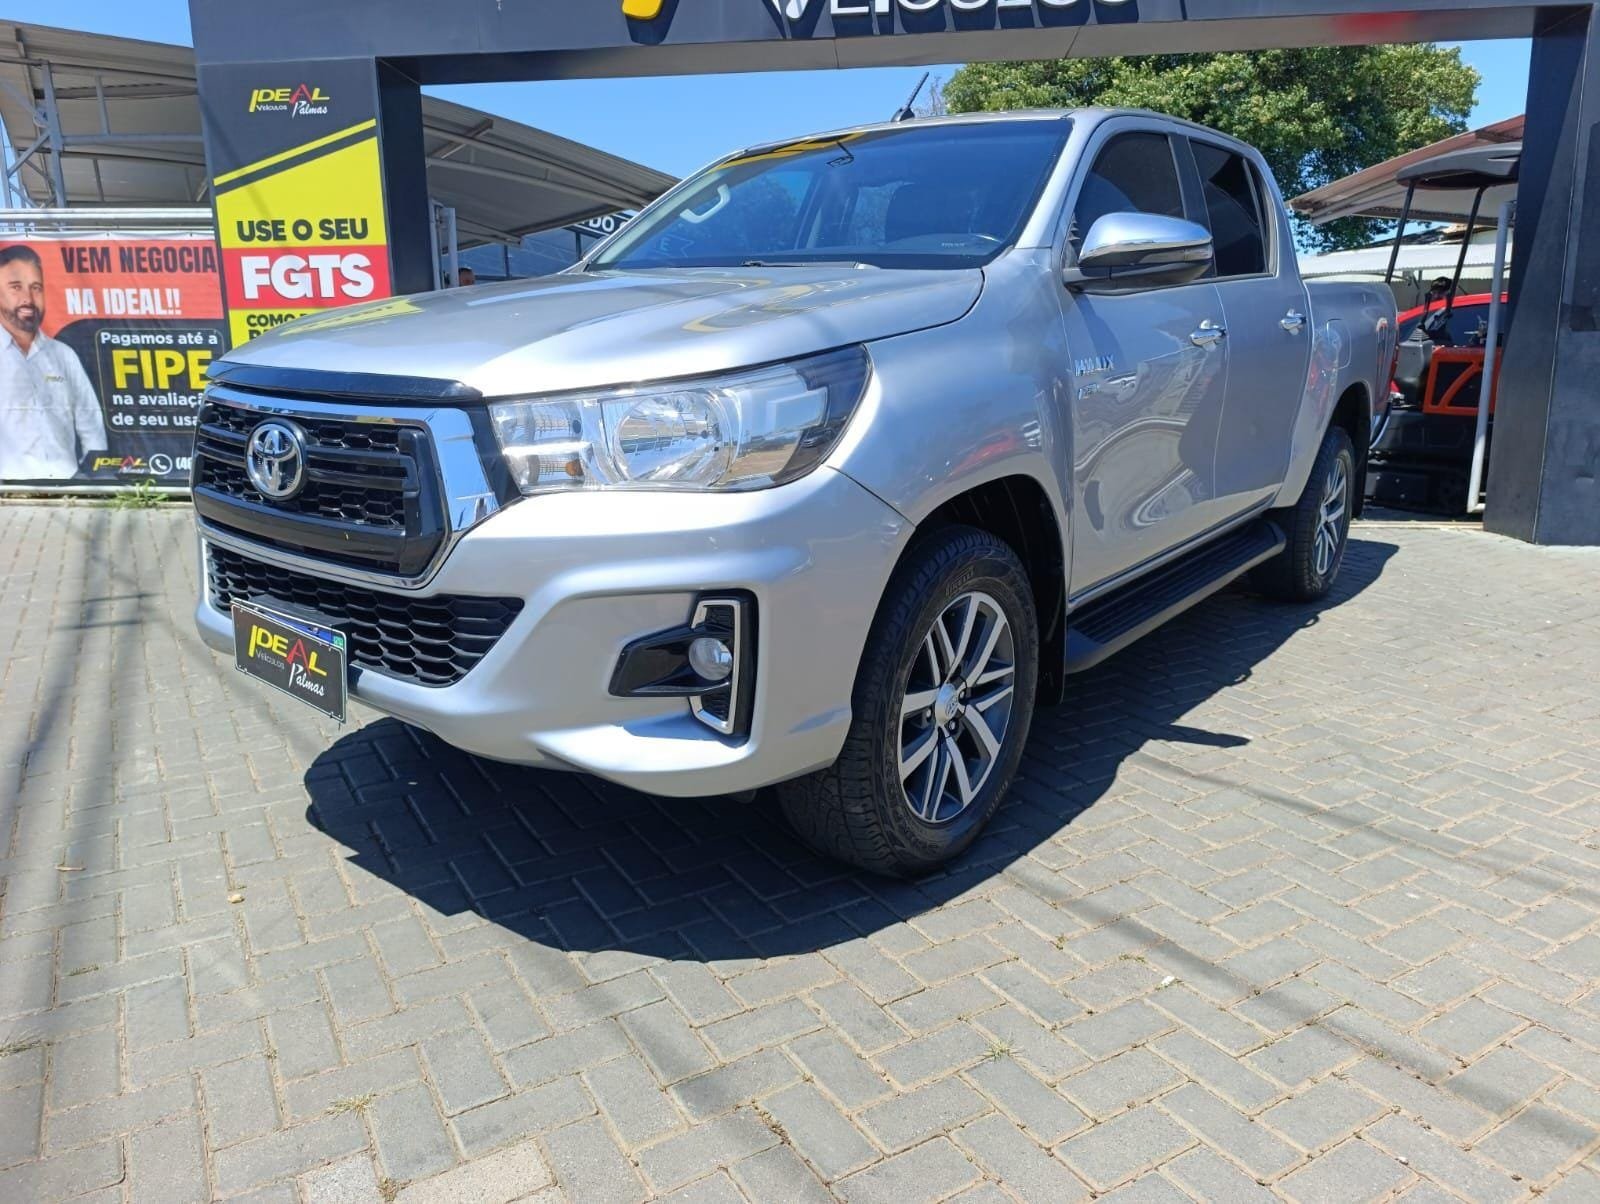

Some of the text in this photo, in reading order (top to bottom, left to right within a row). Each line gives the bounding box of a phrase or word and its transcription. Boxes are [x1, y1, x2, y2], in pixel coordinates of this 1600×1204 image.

[249, 83, 330, 112] IDEAL
[292, 100, 328, 119] Palmas
[237, 218, 369, 242] USE O SEU
[61, 246, 217, 274] VEM NEGOCIA
[241, 253, 374, 299] FGTS
[65, 288, 182, 315] NA IDEAL!!
[100, 332, 218, 346] Pagamos até a
[112, 350, 213, 389] FIPE
[112, 394, 134, 405] na
[112, 412, 134, 426] de
[140, 415, 168, 426] seu
[248, 624, 327, 677] IDEAL
[288, 662, 326, 697] Palmas
